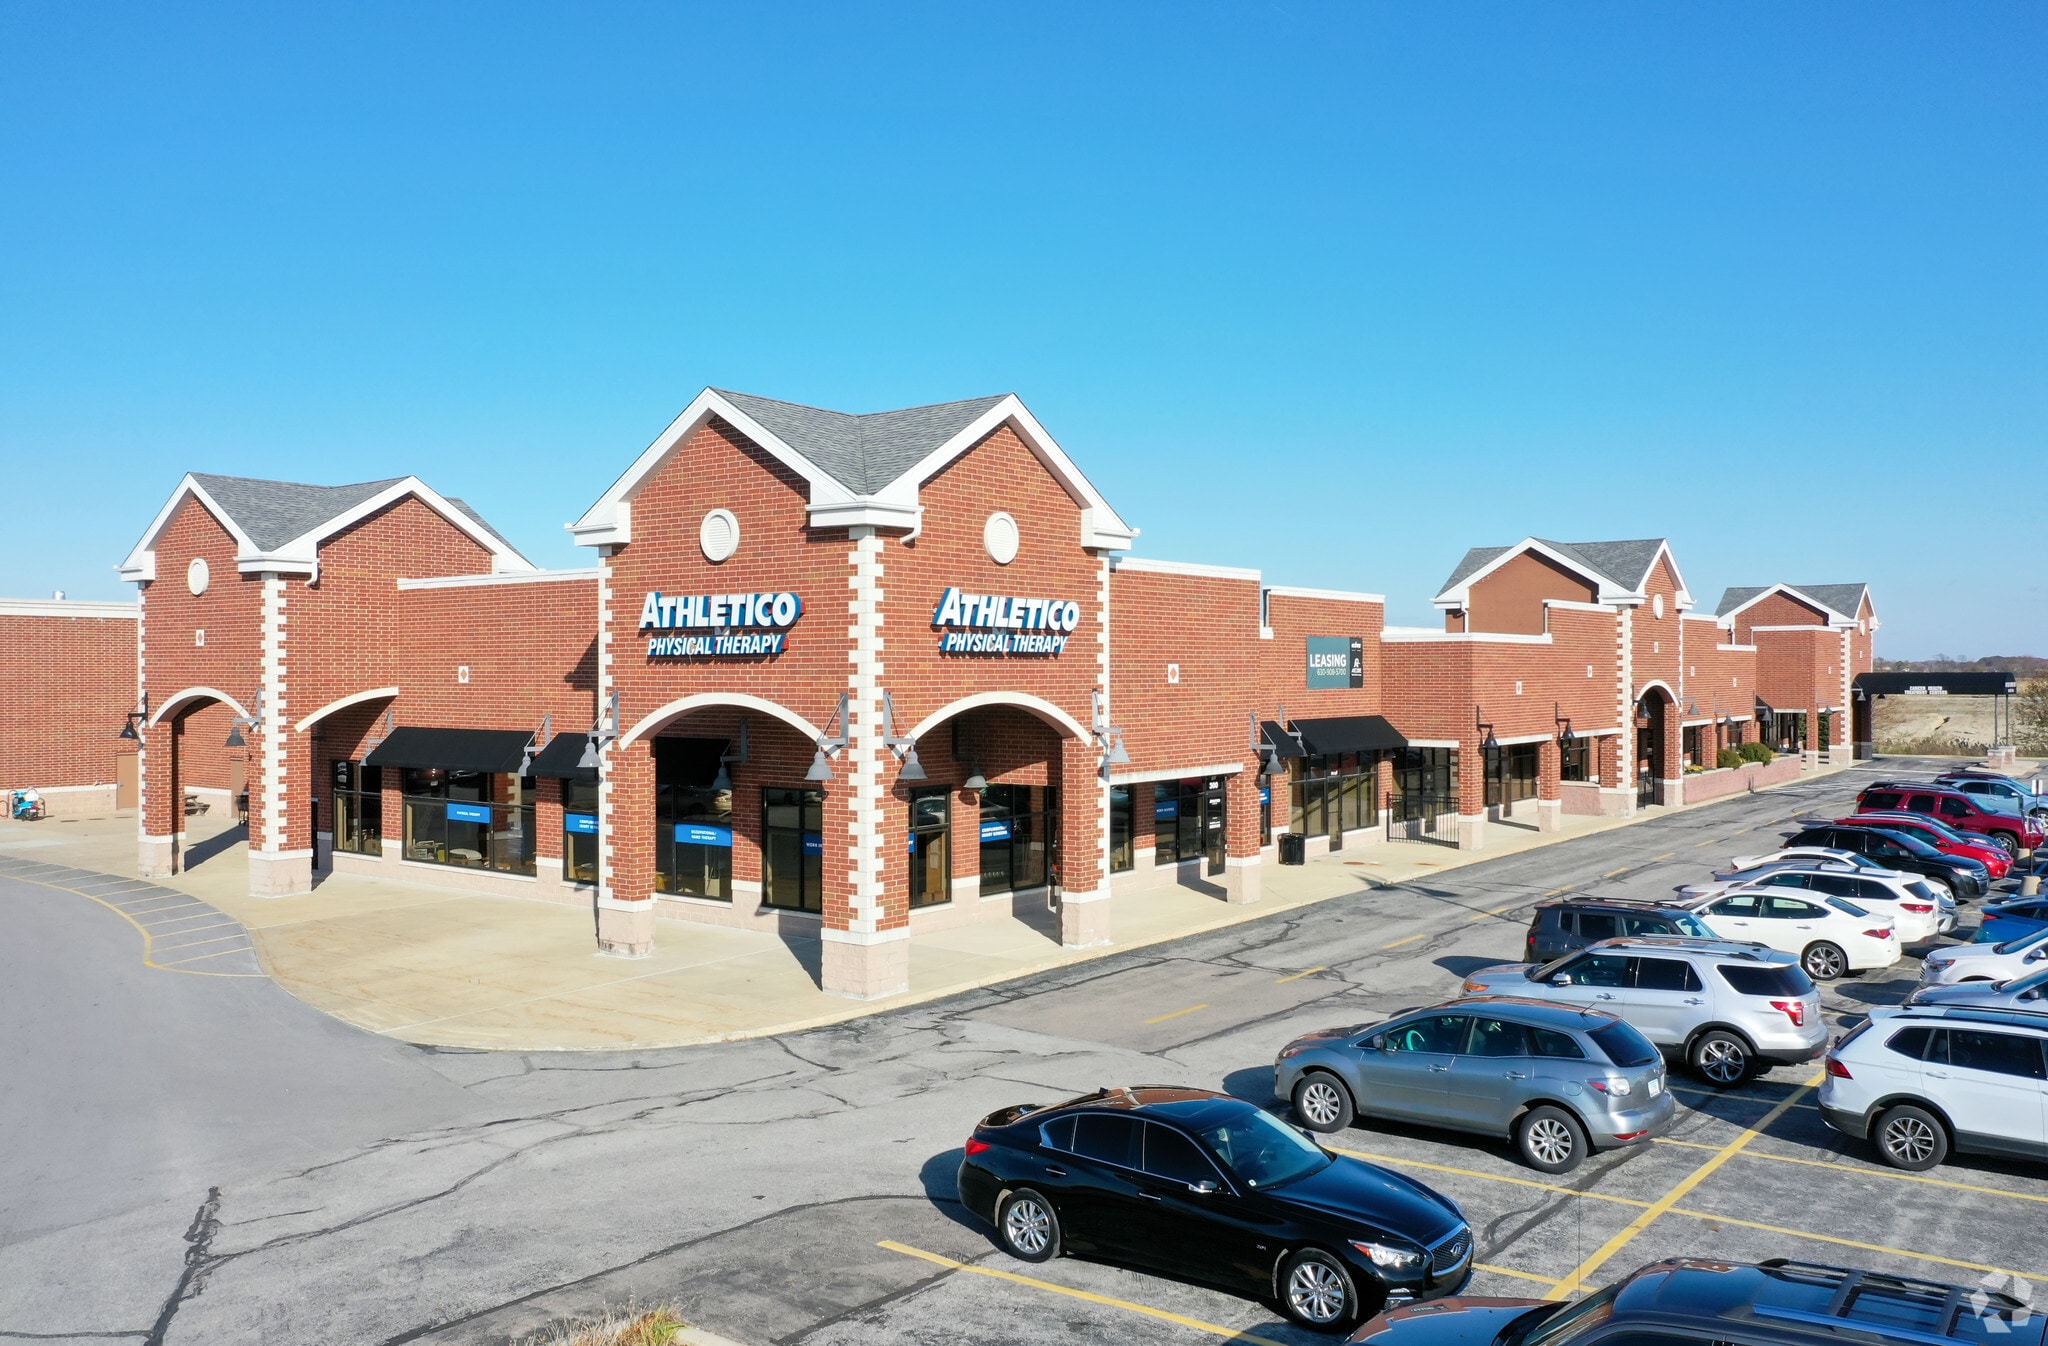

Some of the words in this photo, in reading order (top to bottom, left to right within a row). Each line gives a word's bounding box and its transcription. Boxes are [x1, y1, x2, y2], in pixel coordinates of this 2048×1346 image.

[638, 591, 799, 629] ATHLETICO
[936, 587, 1080, 631] ATHLETICO
[647, 637, 712, 656] PHYSICAL
[715, 634, 782, 654] THERAPY
[946, 632, 1011, 652] PHYSICAL
[1013, 634, 1068, 653] THERAPY
[1310, 654, 1346, 668] LEASING
